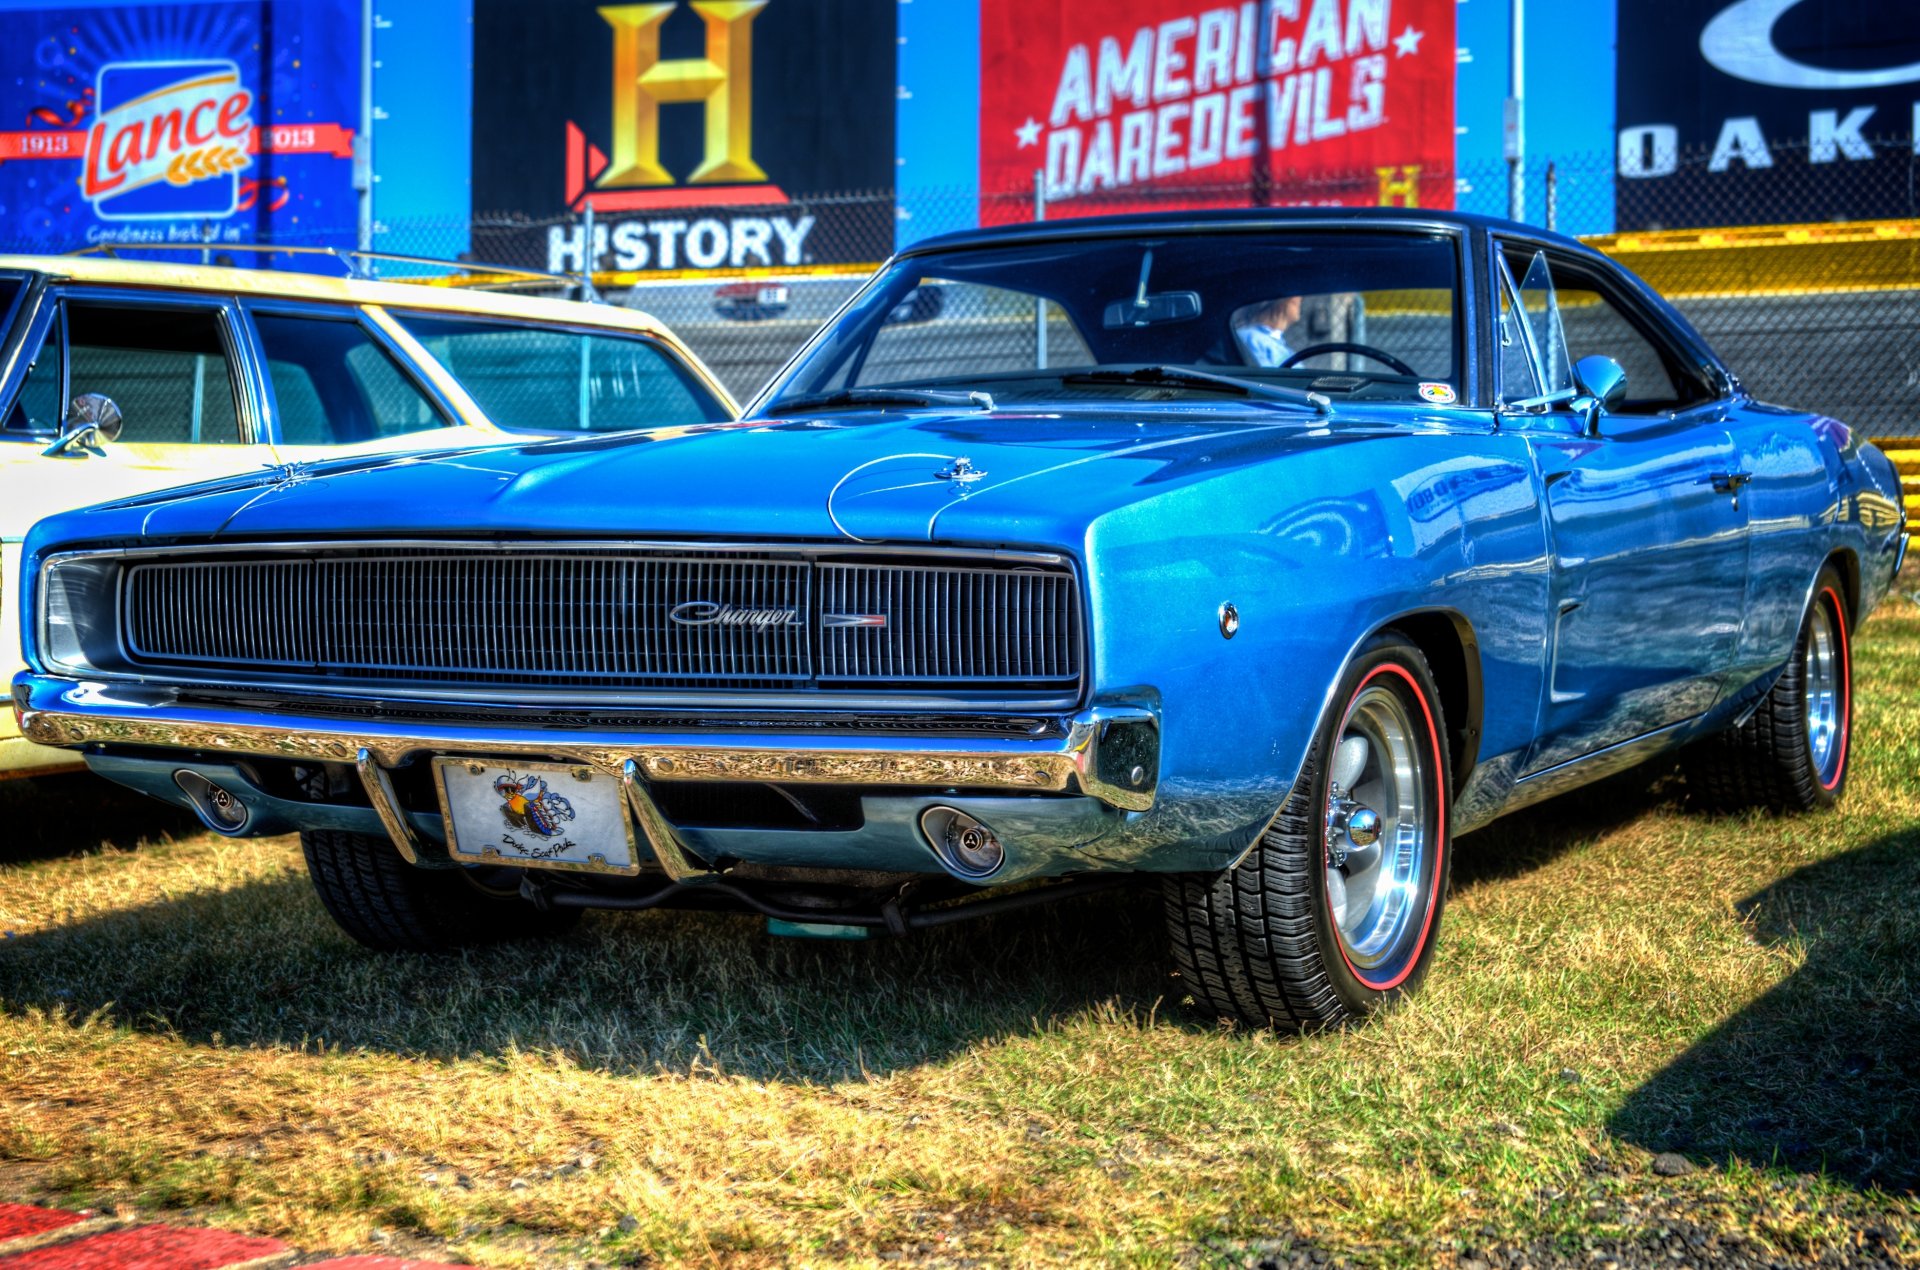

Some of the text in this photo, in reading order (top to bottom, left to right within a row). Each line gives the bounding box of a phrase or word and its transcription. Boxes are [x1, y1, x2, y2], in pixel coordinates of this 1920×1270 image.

[596, 0, 771, 187] H
[1050, 0, 1391, 127] AMERICAN
[20, 135, 69, 153] 1913
[85, 91, 250, 197] Lance
[1044, 55, 1387, 201] DAREDEVILS
[1617, 101, 1920, 179] OAK
[547, 216, 815, 274] HISTORY
[669, 601, 804, 633] Charger
